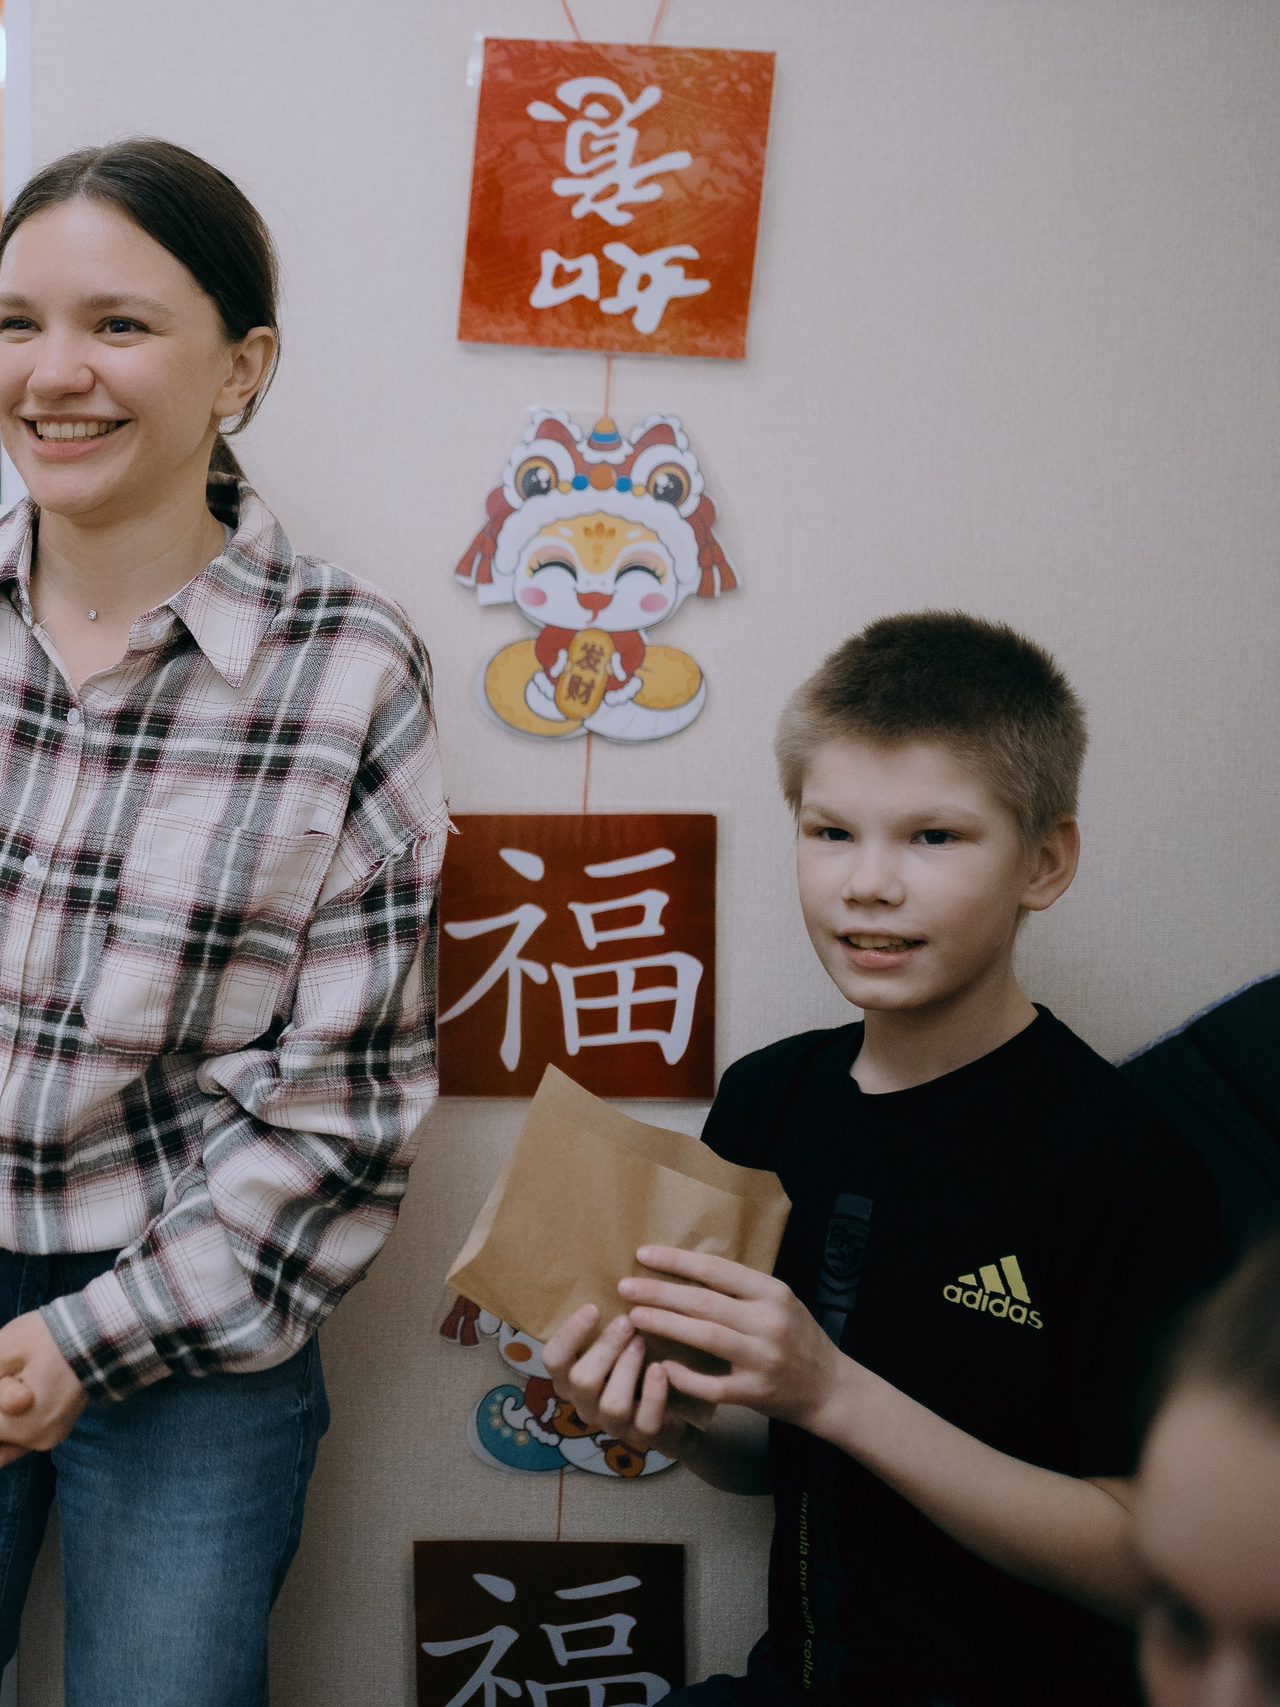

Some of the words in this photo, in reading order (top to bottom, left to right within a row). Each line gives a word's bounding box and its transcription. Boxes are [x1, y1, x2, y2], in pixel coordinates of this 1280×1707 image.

[437, 848, 704, 1072] 福
[943, 1284, 1044, 1330] adidas
[798, 1491, 809, 1555] formula
[799, 1559, 808, 1591] one
[800, 1596, 815, 1635] team
[801, 1639, 813, 1690] collab
